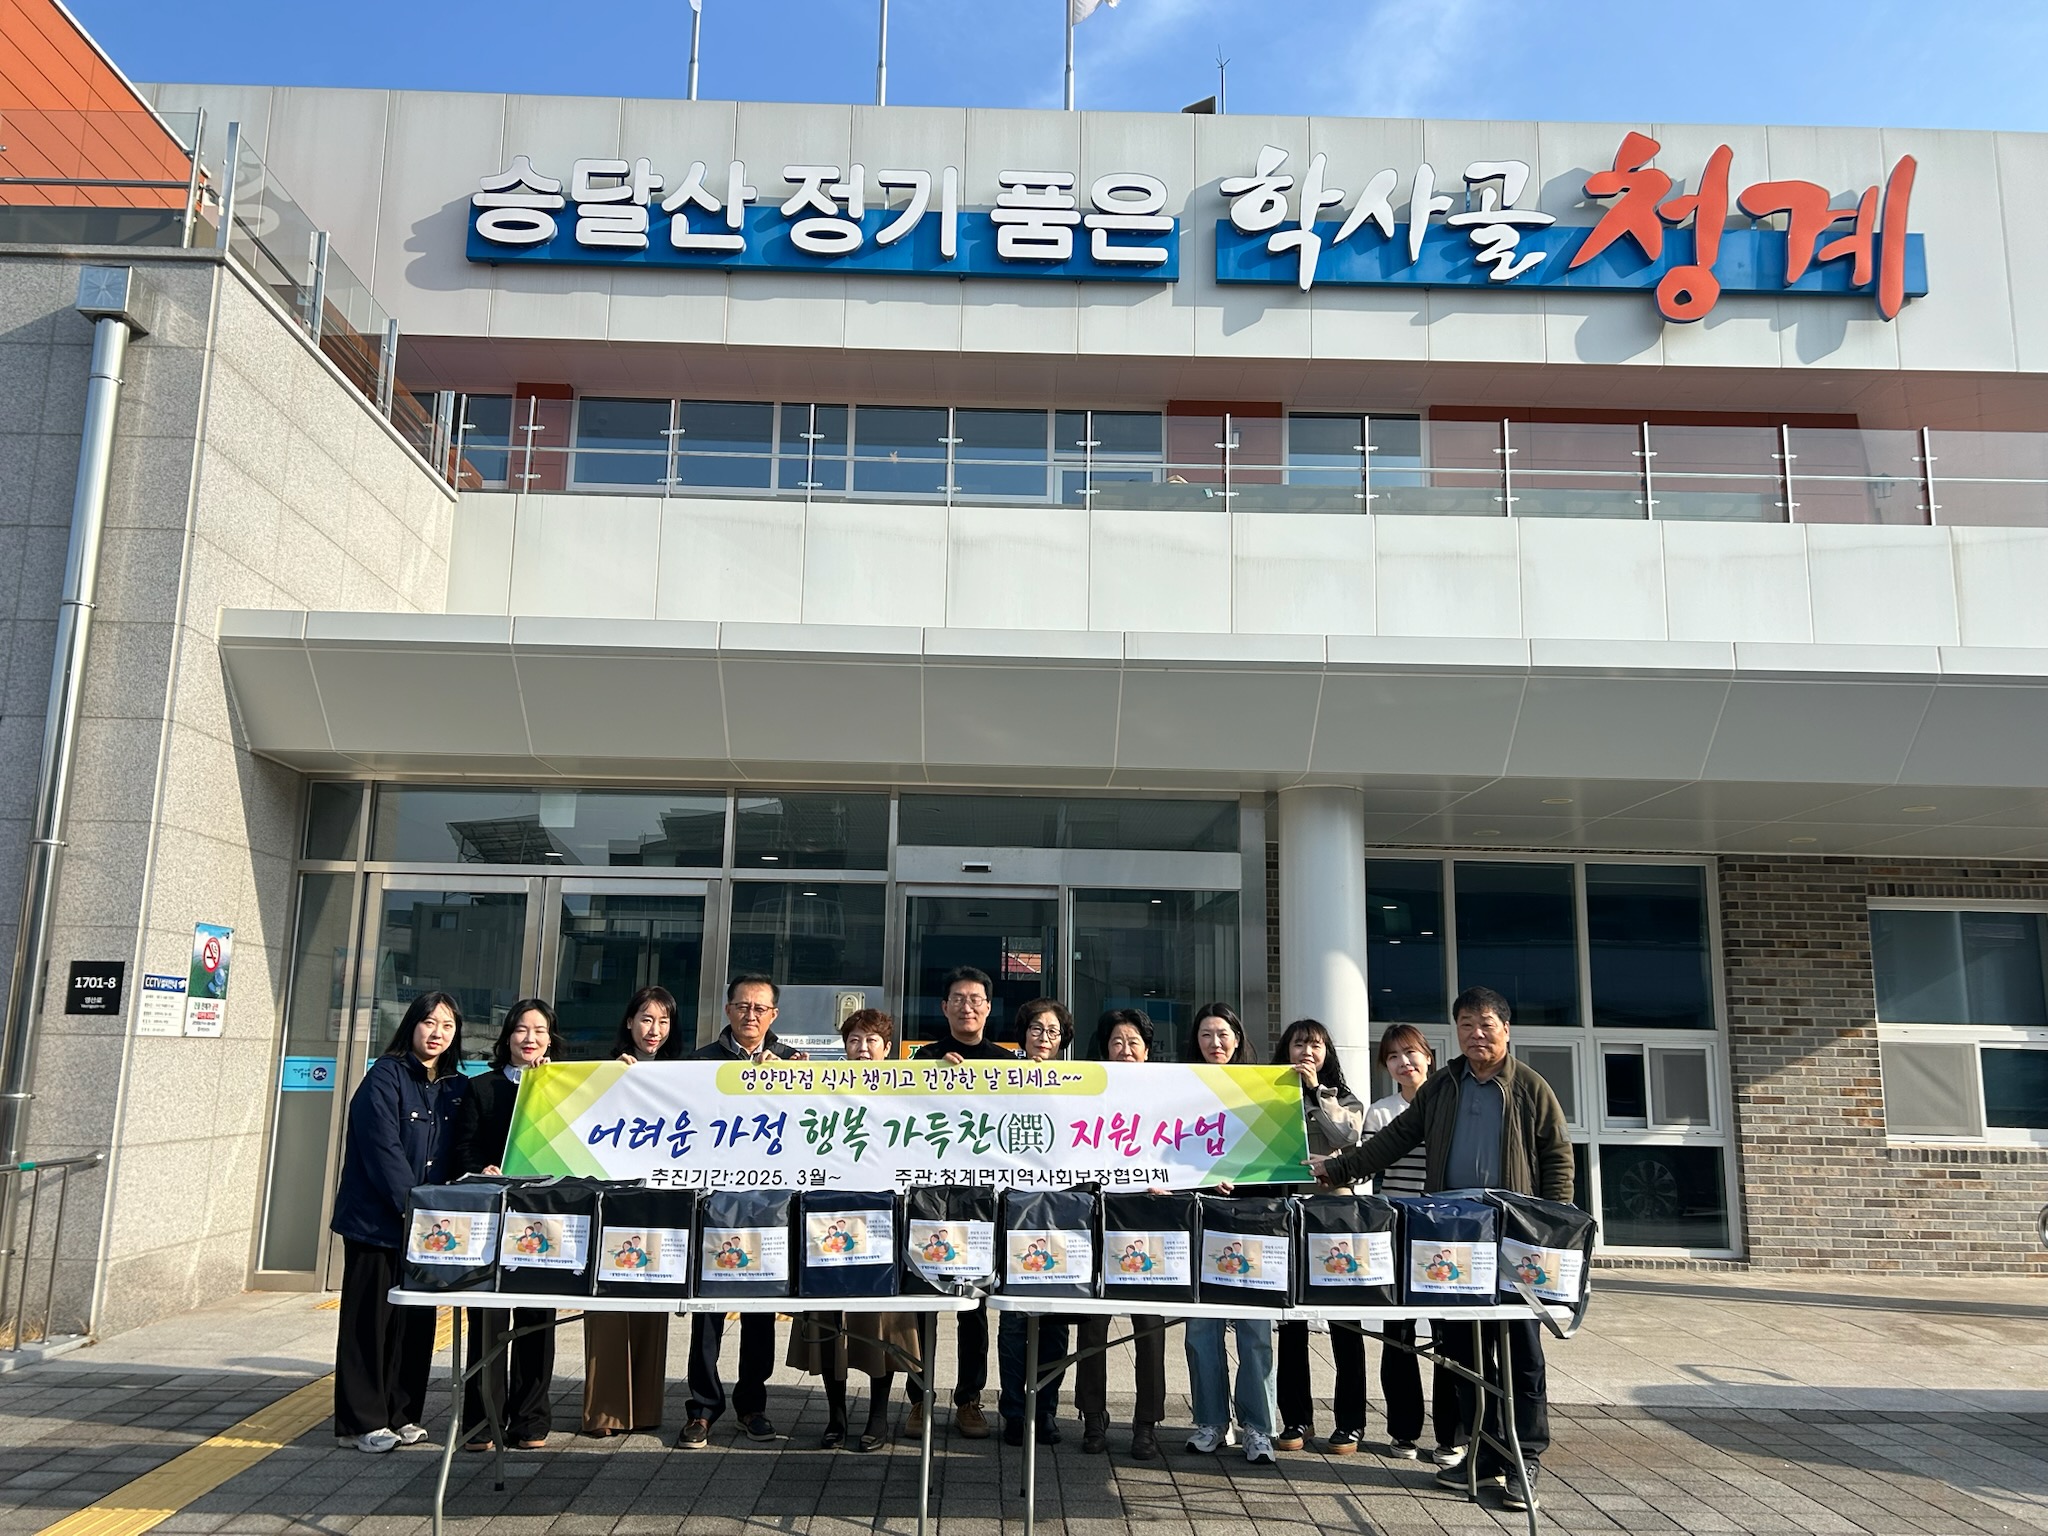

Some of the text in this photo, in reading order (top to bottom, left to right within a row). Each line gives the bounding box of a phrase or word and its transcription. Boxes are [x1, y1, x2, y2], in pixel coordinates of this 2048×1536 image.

[471, 131, 1917, 324] 승달산 정기 품은 학사골 청계
[74, 976, 117, 989] 1701-8
[740, 1068, 813, 1090] 영양만점
[821, 1068, 857, 1091] 식사
[862, 1068, 916, 1090] 챙기고
[922, 1067, 977, 1091] 건강한
[983, 1068, 1001, 1090] 날
[588, 1109, 698, 1159] 어려운
[709, 1111, 788, 1156] 가정
[798, 1106, 870, 1162] 행복
[1070, 1111, 1142, 1157] 지원
[1152, 1112, 1226, 1156] 사업
[796, 1168, 842, 1187] 3월~
